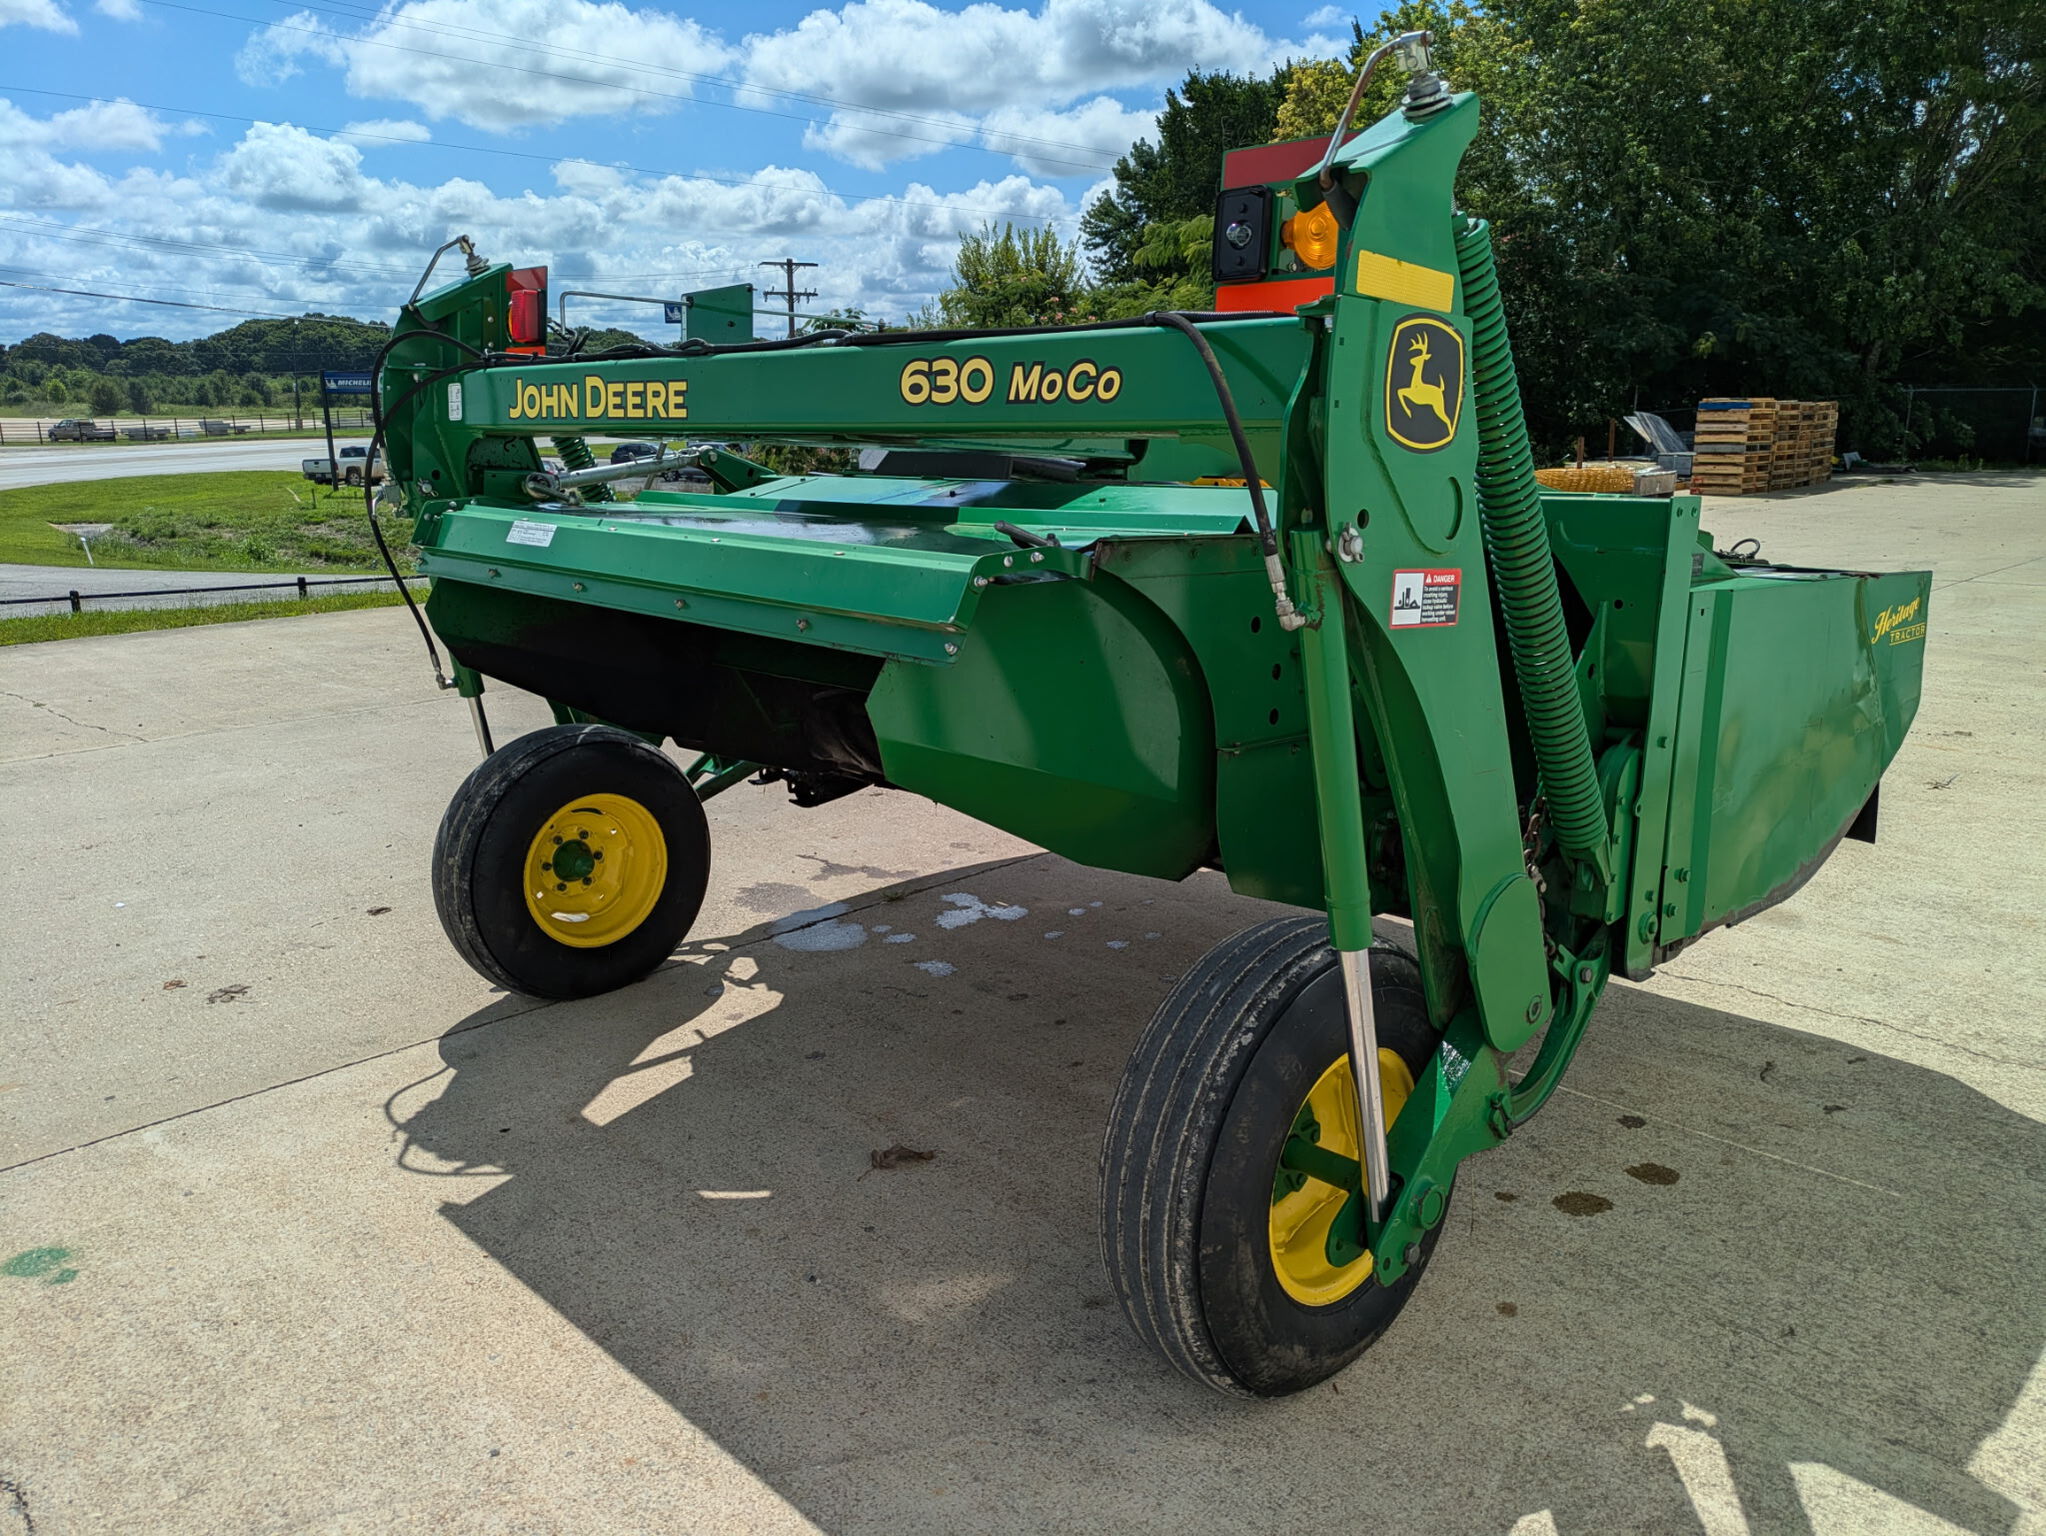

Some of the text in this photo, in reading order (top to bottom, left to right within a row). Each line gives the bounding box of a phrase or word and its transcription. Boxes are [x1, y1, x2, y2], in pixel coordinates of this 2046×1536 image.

[508, 377, 579, 419] JOHN
[584, 374, 688, 419] DEERE
[900, 355, 1123, 406] 630 MoCo
[1433, 574, 1455, 583] DANGER
[1871, 597, 1920, 644] Heritage
[1890, 625, 1926, 643] TRACTOR
